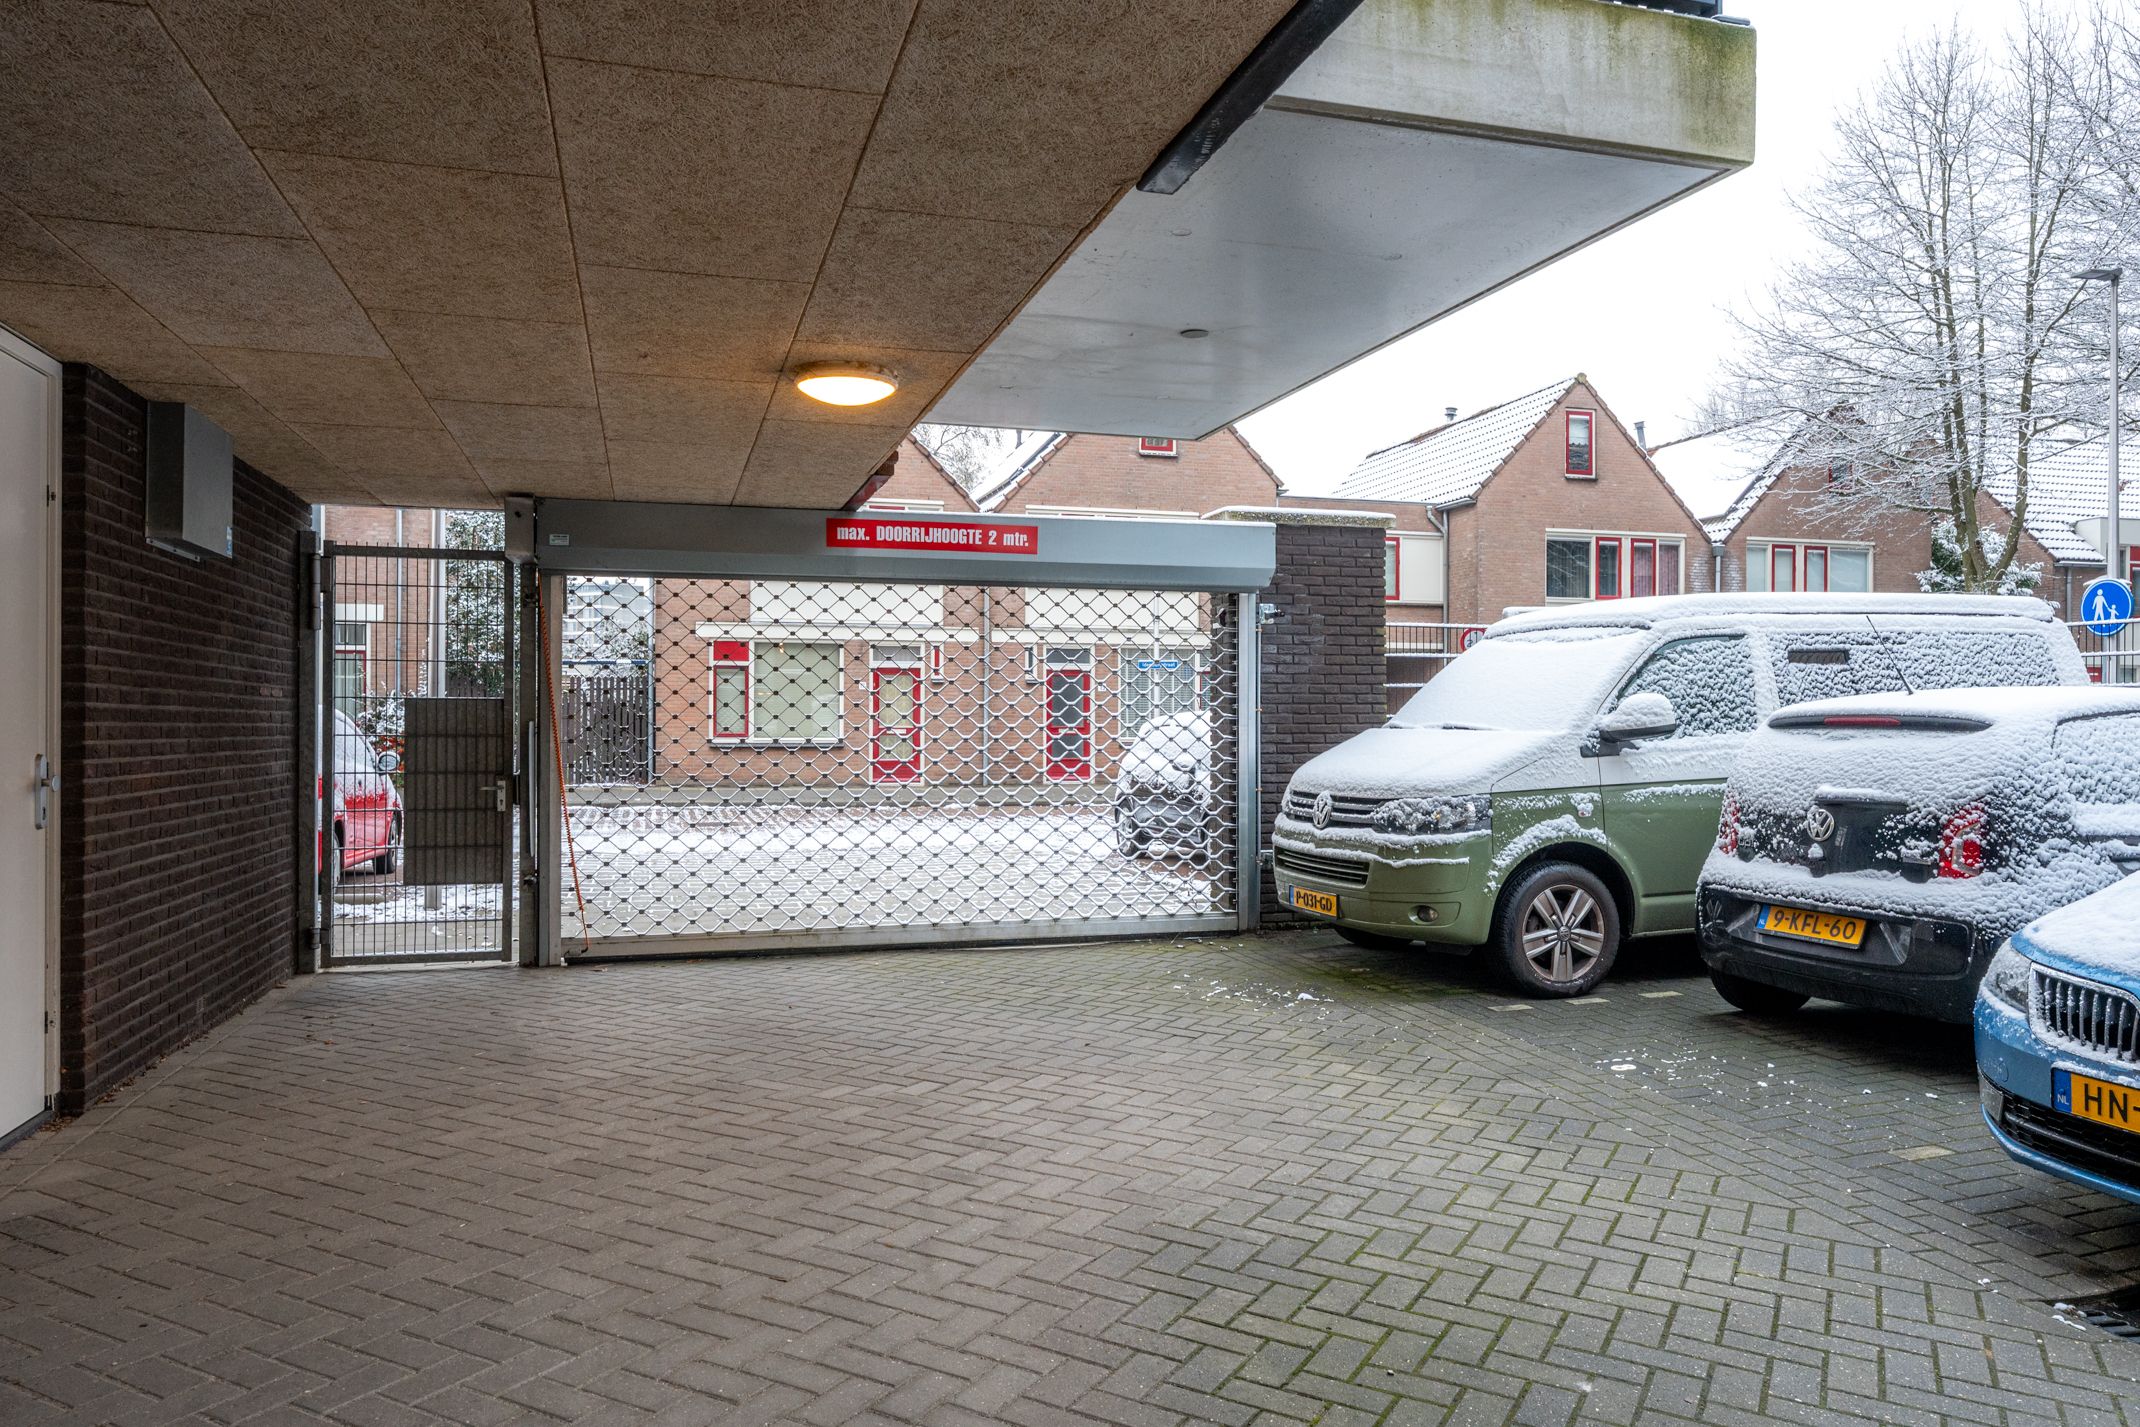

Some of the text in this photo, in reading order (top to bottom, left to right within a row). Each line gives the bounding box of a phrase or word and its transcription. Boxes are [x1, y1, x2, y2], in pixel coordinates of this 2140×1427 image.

[837, 525, 1029, 547] max. DOORRIJHOOGTE 2 mtr.
[1296, 890, 1333, 912] P-031-GD
[1774, 910, 1857, 940] 9-KFL-60
[2057, 1093, 2070, 1106] NL
